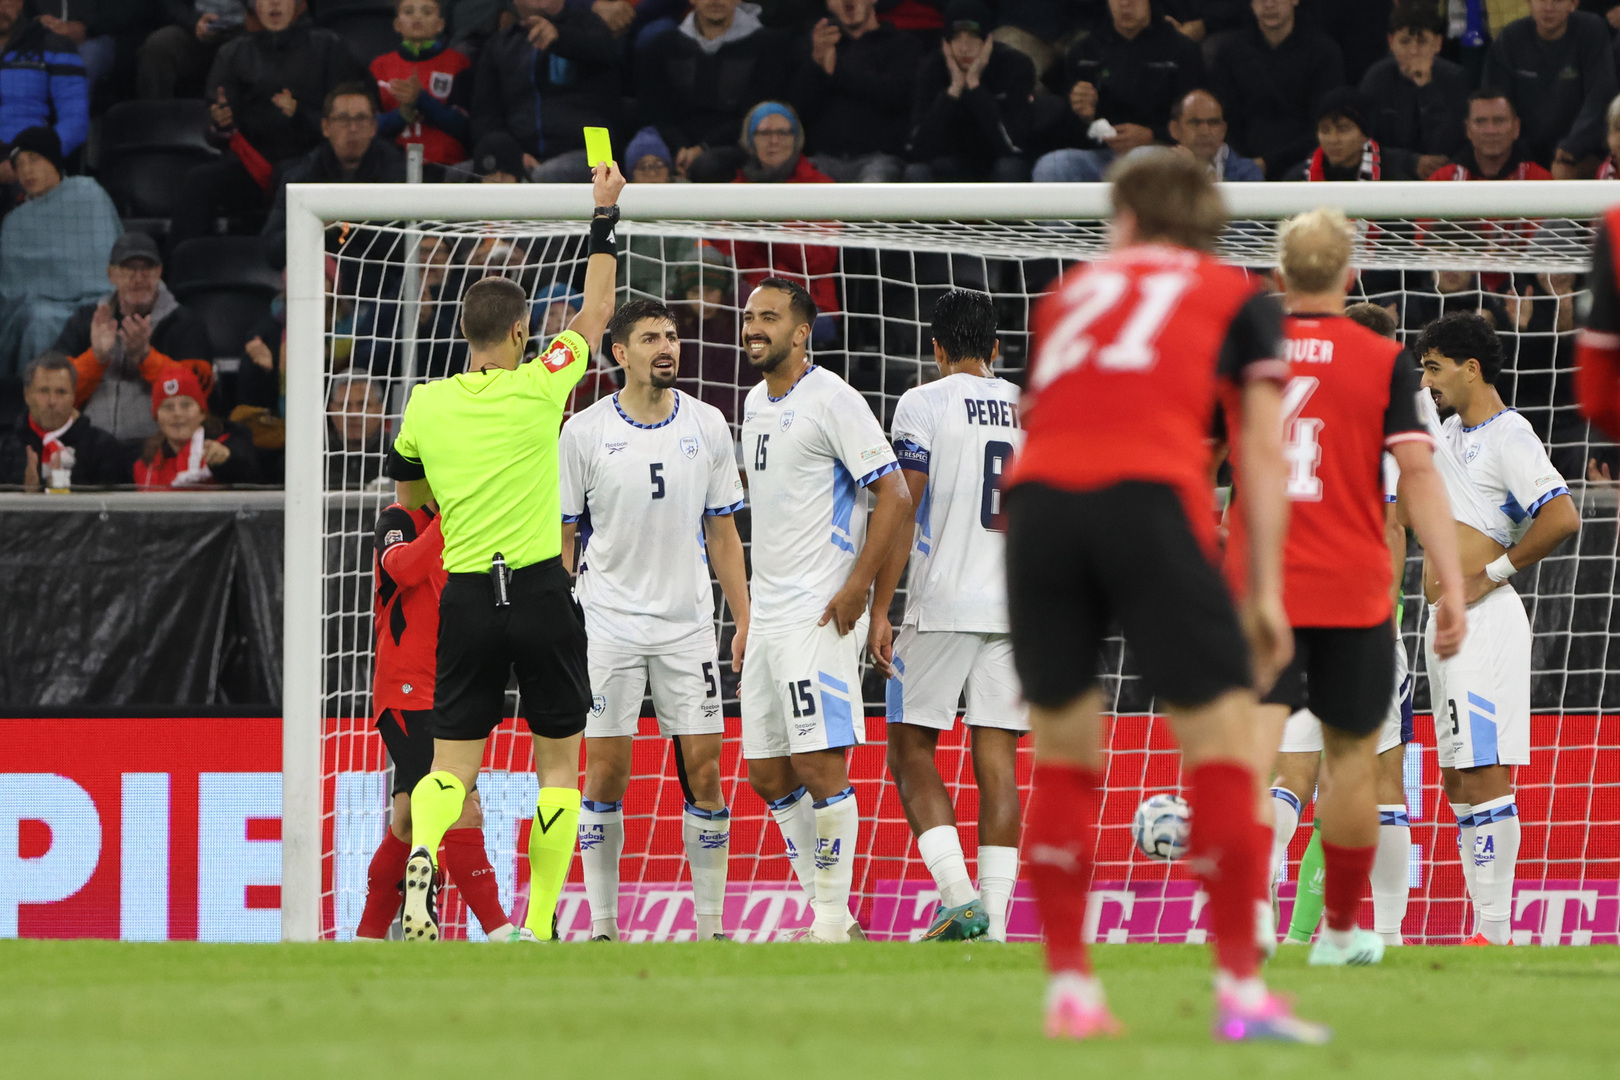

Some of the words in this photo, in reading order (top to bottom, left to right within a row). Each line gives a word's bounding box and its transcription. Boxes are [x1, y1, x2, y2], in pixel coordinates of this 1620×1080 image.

[1032, 270, 1188, 391] 21
[605, 441, 628, 449] Reebok
[755, 433, 770, 471] 15
[650, 462, 665, 500] 5
[980, 440, 1014, 532] 8
[701, 661, 717, 699] 5
[788, 679, 816, 718] 15
[1448, 698, 1460, 736] 3
[579, 831, 605, 842] eebok
[629, 890, 698, 942] T
[733, 890, 809, 942] T
[1512, 890, 1598, 945] T
